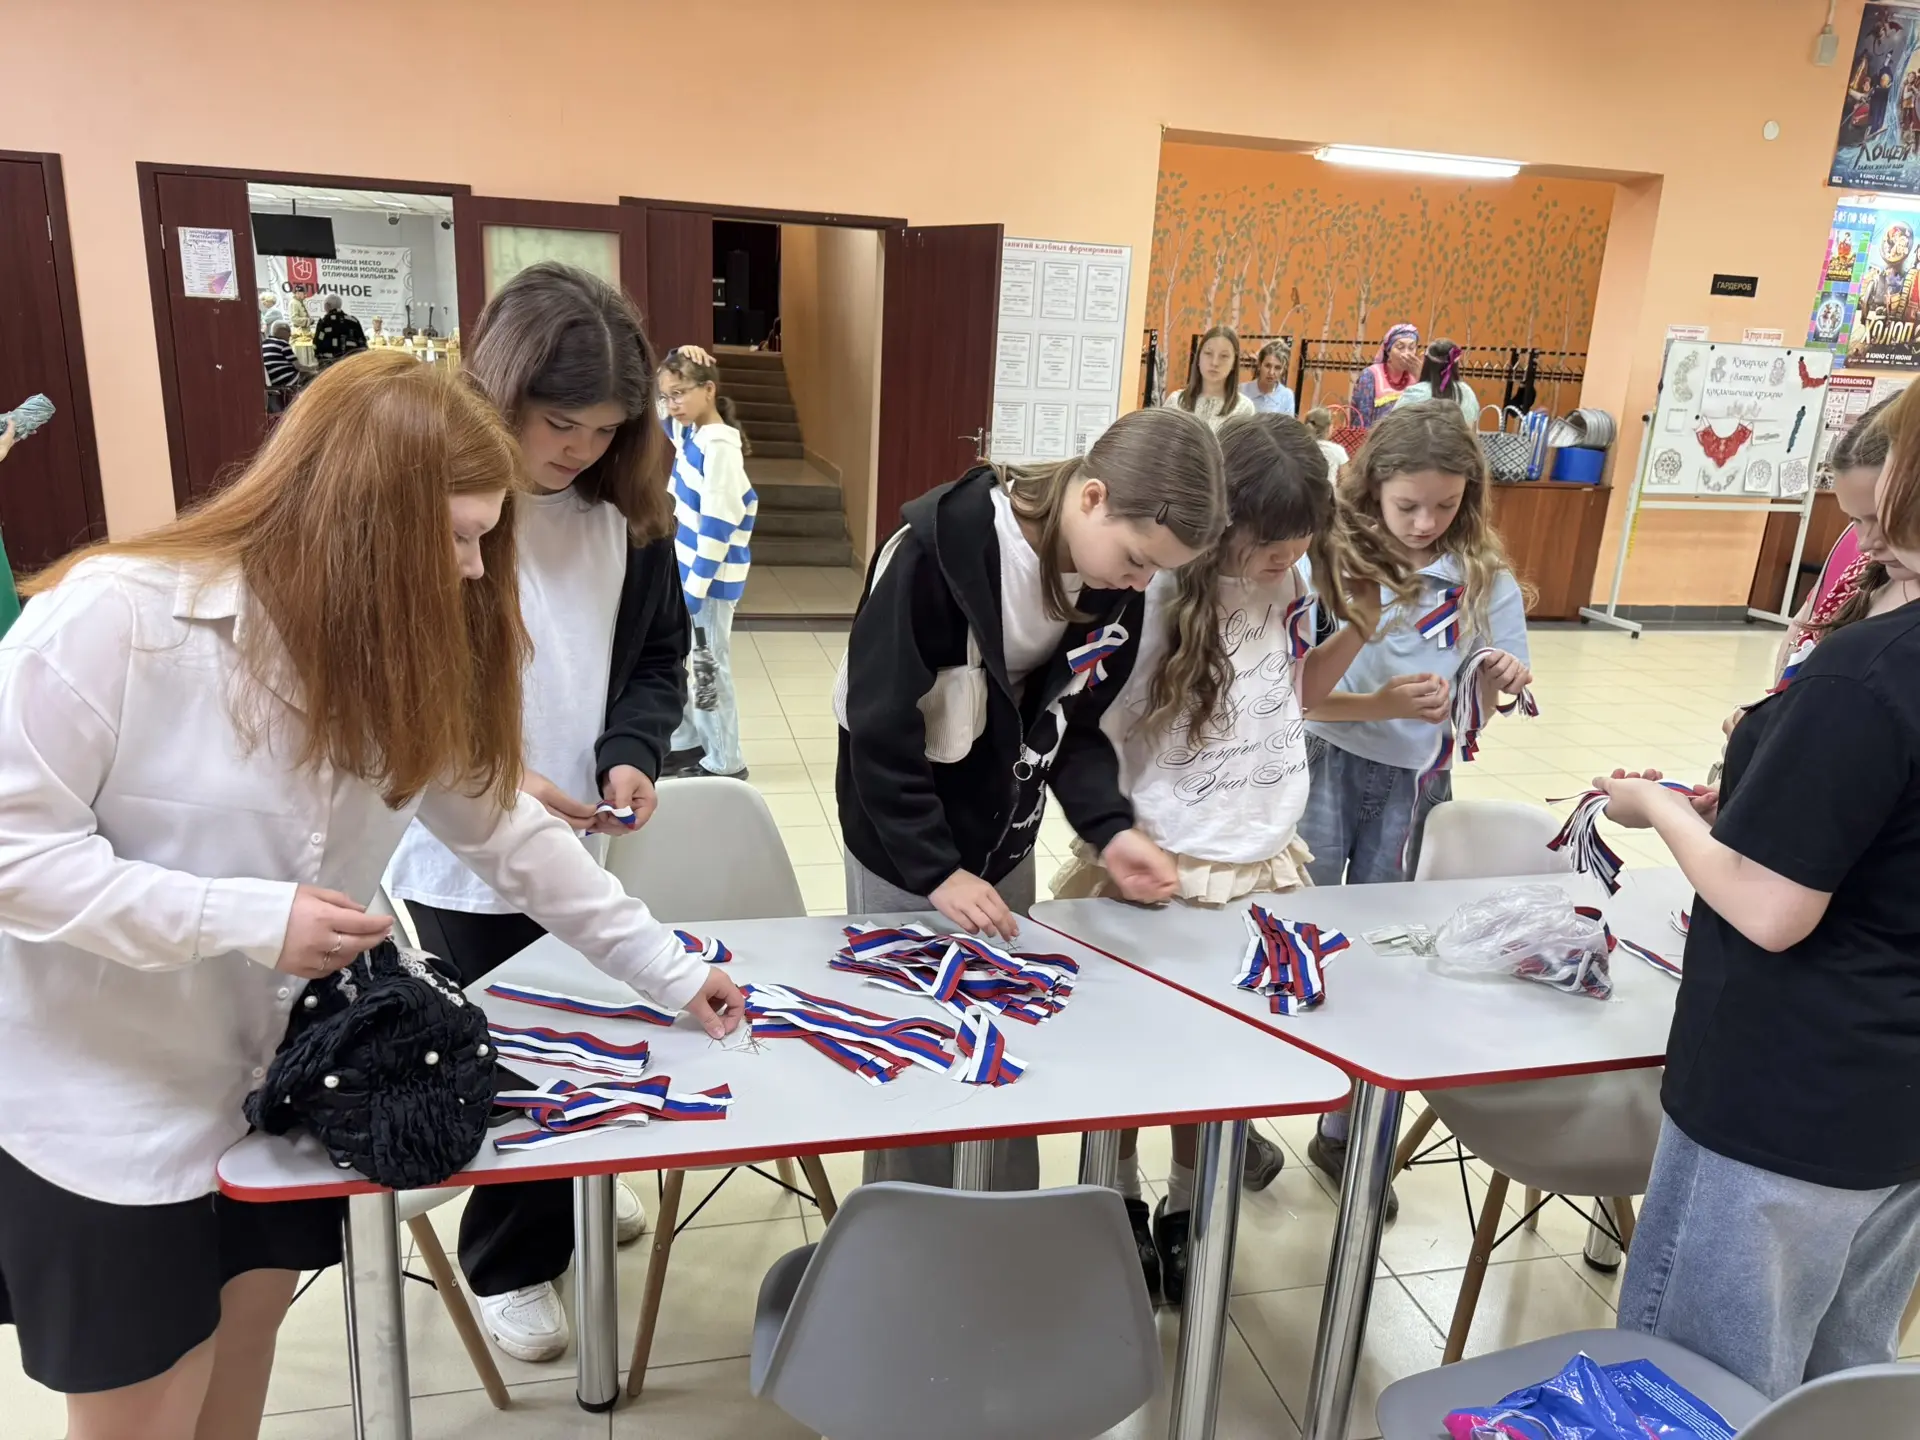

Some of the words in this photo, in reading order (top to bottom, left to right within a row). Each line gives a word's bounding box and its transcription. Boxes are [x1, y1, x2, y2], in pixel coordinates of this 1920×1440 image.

[1717, 281, 1752, 291] ГАРДЕРОБ
[1861, 319, 1914, 345] ХОЛОП
[1833, 377, 1872, 386] БЕЗОПАСНОСТЬ
[1173, 770, 1249, 807] Your
